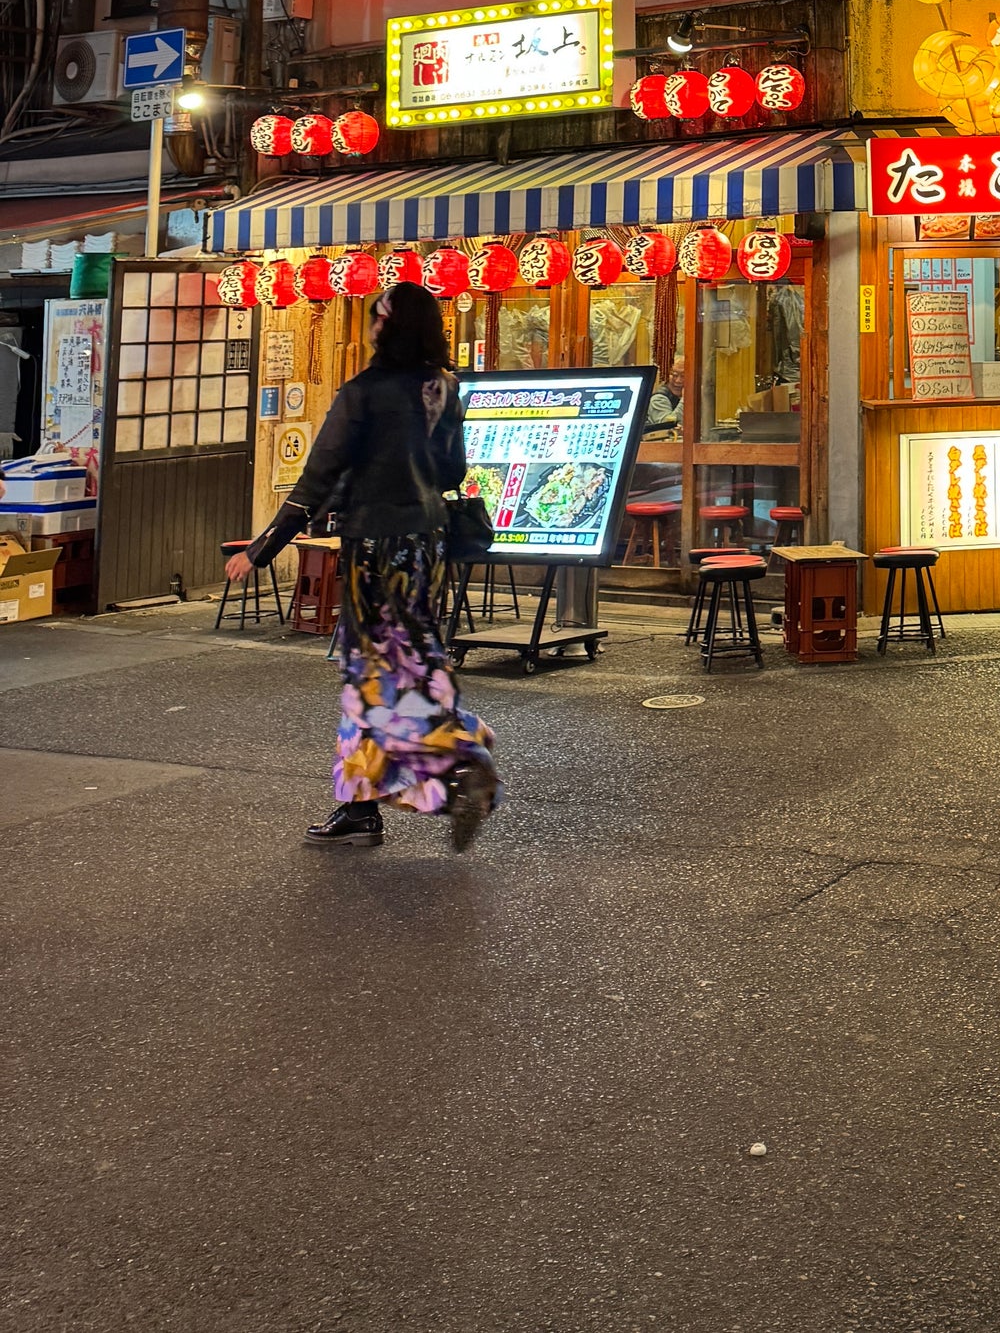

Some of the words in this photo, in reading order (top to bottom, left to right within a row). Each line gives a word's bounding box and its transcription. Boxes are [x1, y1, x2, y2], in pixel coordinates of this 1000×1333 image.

[132, 102, 172, 118] ここまで
[958, 153, 977, 197] 本場
[747, 234, 777, 276] はみご
